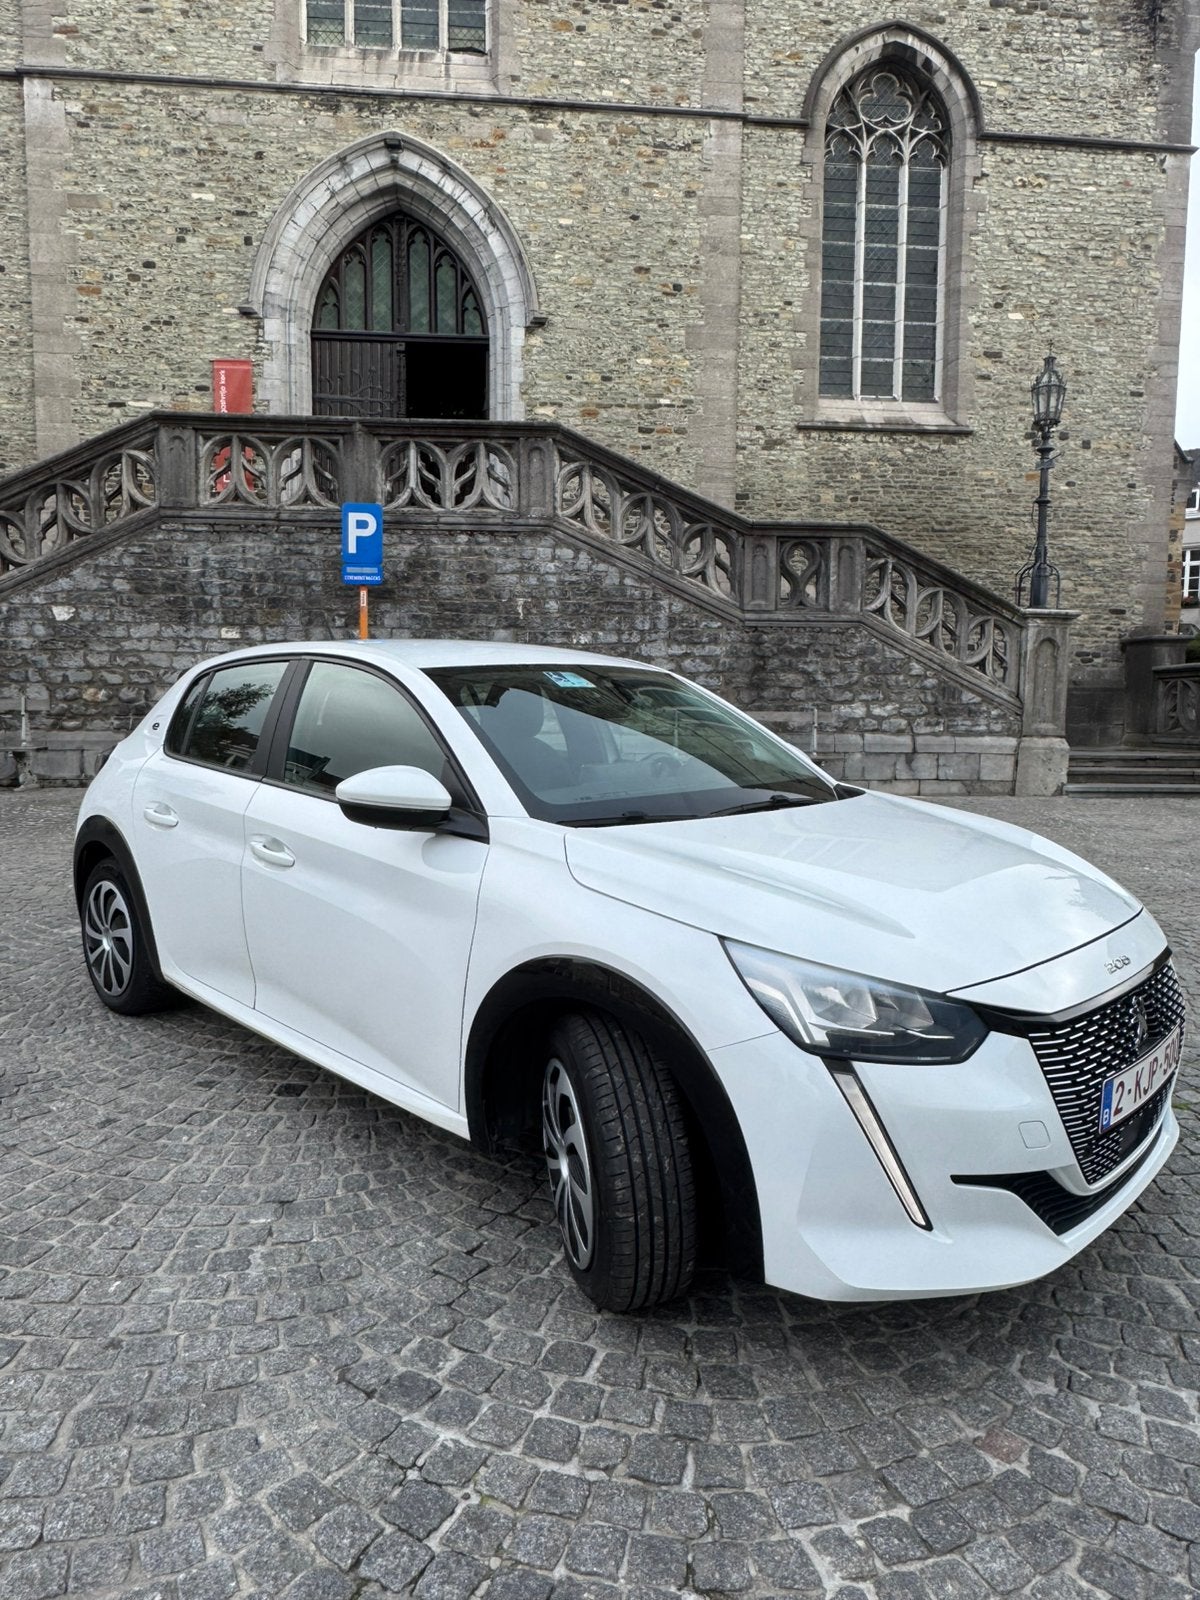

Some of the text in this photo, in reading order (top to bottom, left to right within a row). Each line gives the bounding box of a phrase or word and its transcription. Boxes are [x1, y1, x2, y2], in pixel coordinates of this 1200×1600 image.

[348, 512, 377, 554] P
[1104, 955, 1131, 975] 208
[1102, 1108, 1109, 1125] B
